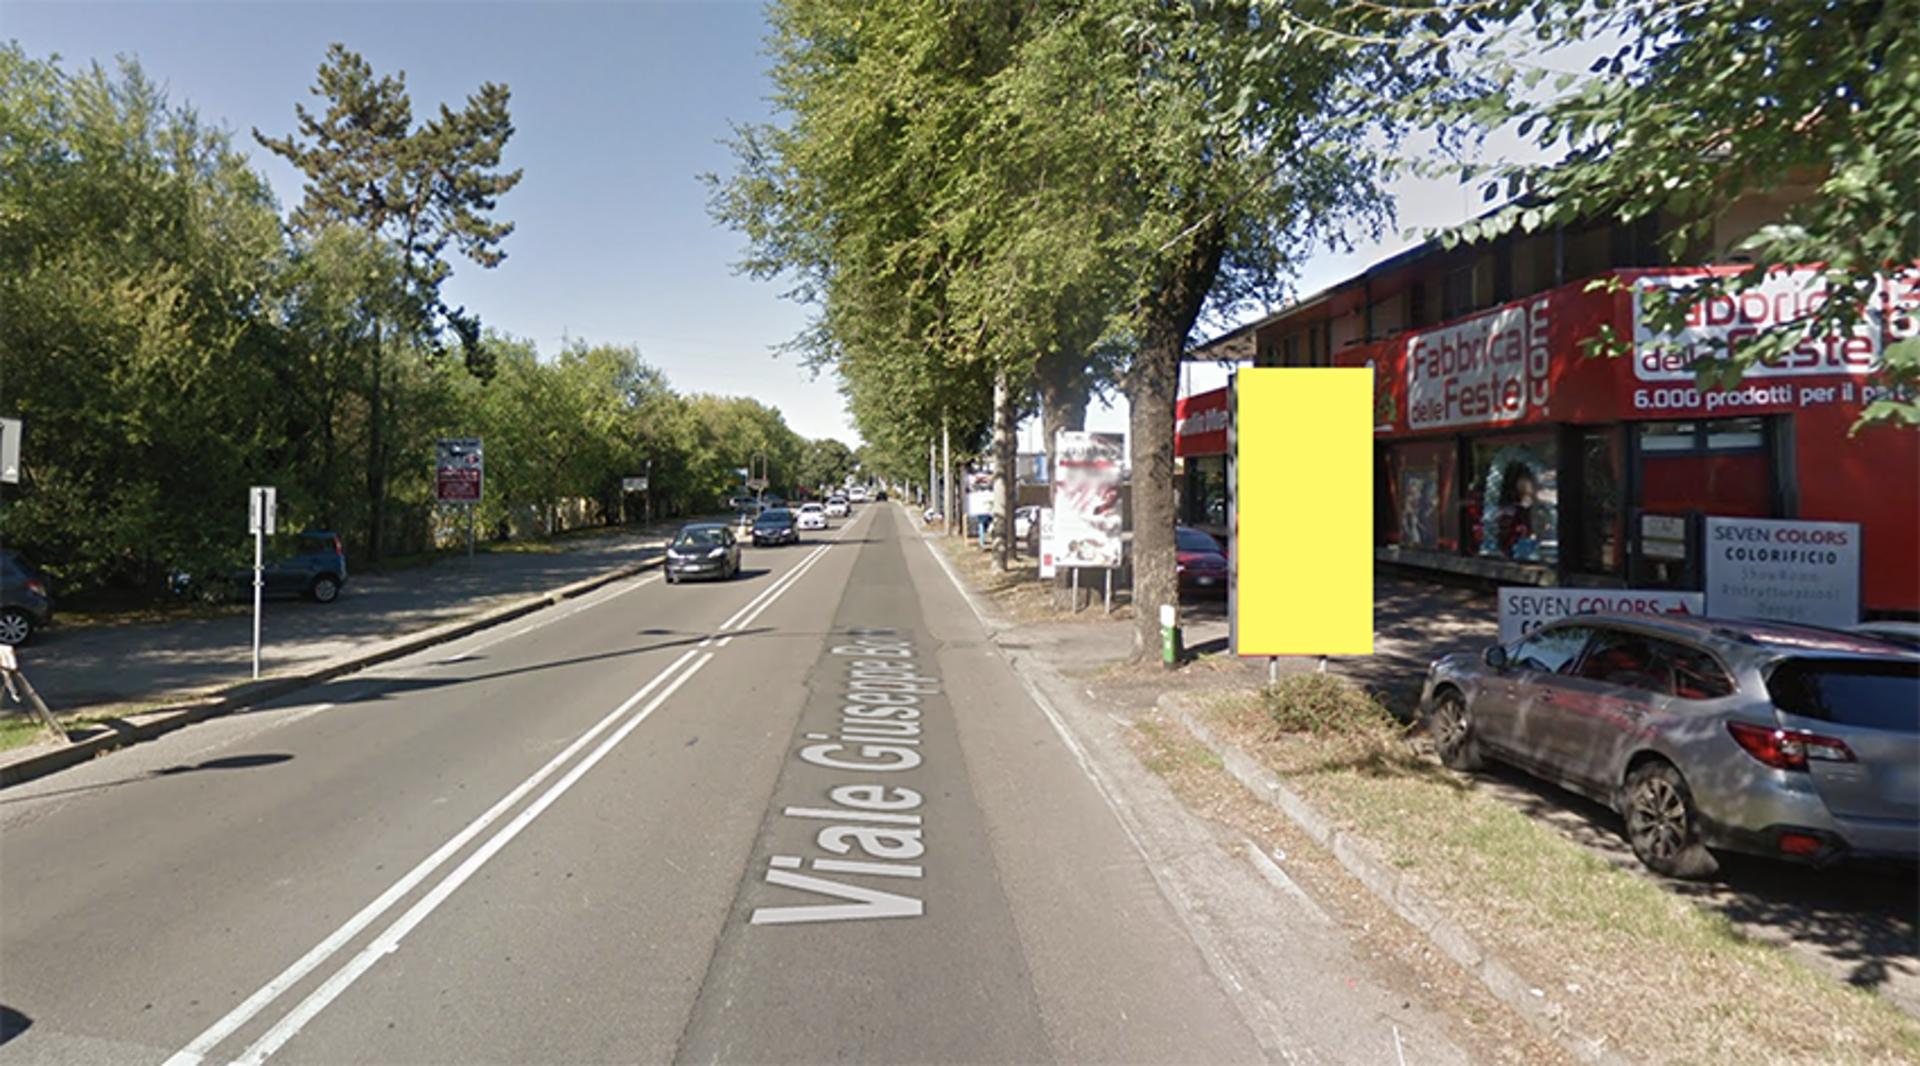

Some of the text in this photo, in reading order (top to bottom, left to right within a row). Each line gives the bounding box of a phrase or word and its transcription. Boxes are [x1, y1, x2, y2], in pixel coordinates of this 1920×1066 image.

[1642, 276, 1866, 327] bbric
[1413, 325, 1522, 381] Fabbrica
[1412, 373, 1520, 424] delle Feste
[1634, 389, 1700, 408] 6.000
[1706, 385, 1793, 411] prodotti
[1800, 386, 1836, 406] per
[1842, 382, 1854, 401] il
[1715, 526, 1847, 545] SEVEN COLORS
[1725, 547, 1837, 565] COLORIFICIO
[1508, 596, 1661, 616] SEVEN COLORS
